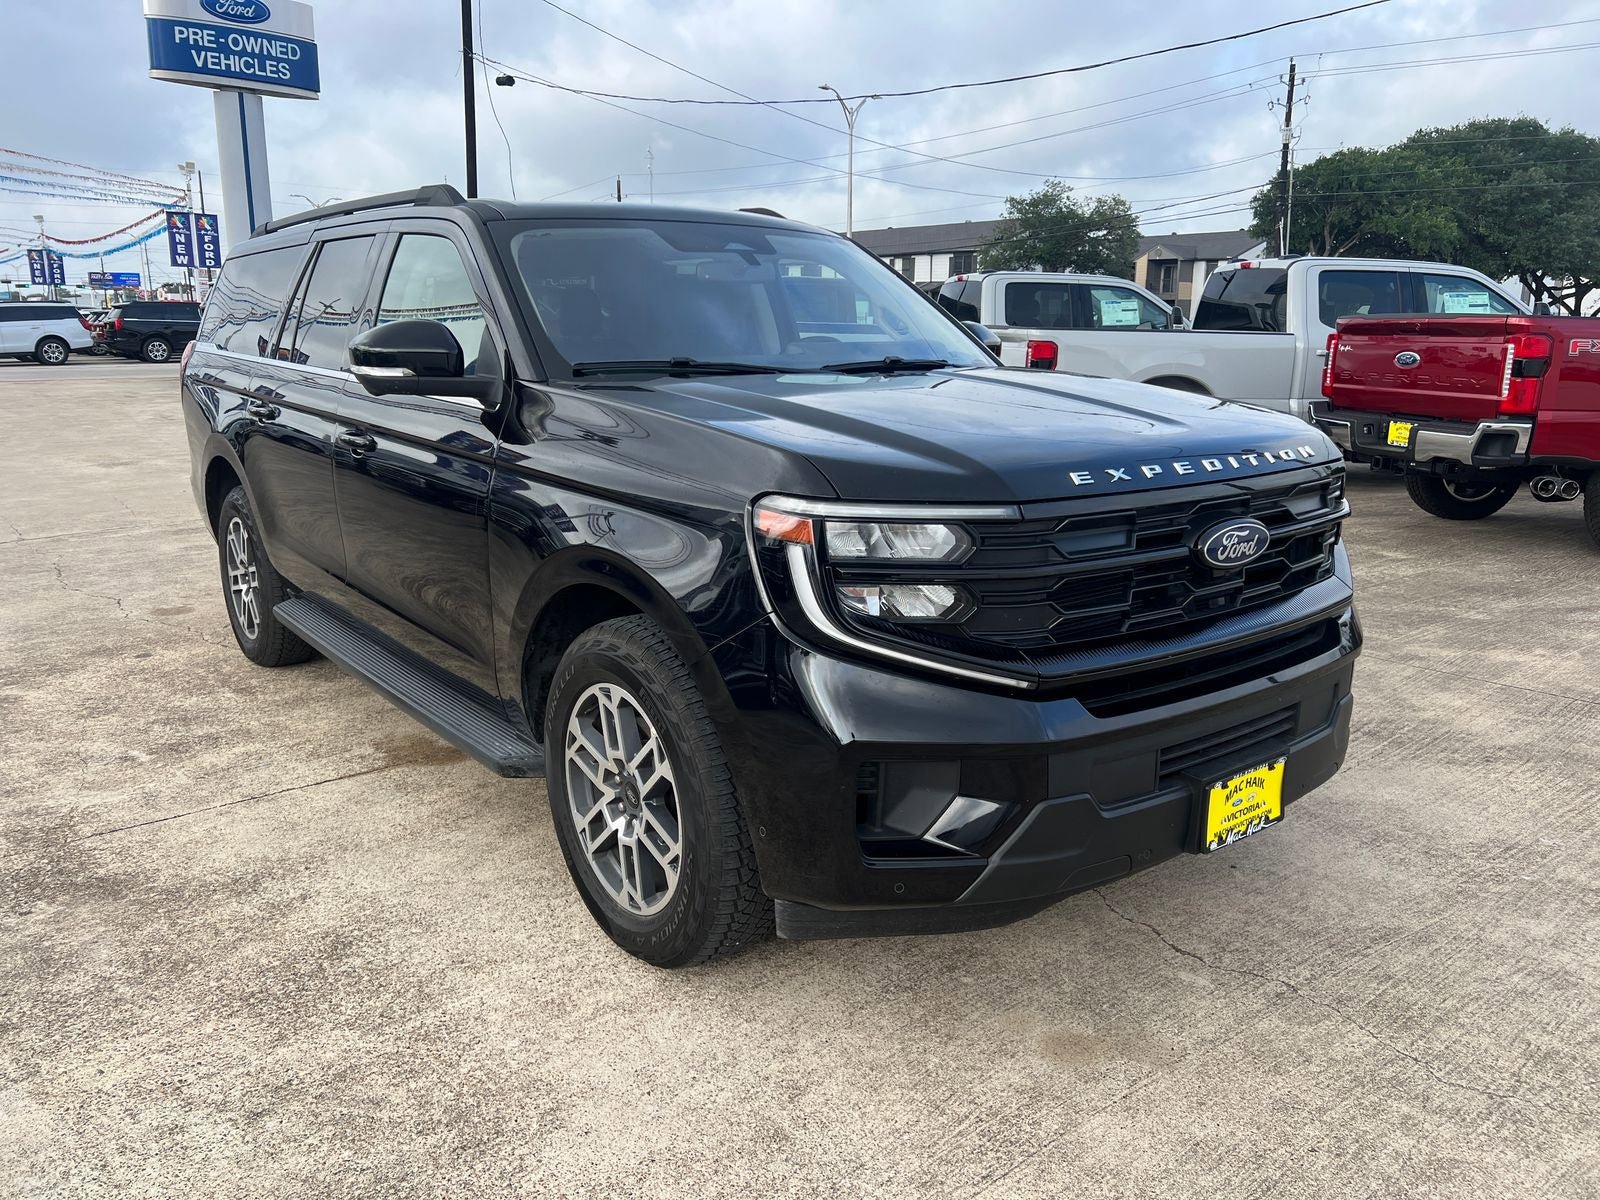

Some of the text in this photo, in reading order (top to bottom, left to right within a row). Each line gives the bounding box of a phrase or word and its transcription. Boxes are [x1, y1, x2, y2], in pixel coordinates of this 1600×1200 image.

[215, 0, 256, 17] Ford
[174, 26, 301, 60] PRE-OWNED
[191, 50, 291, 79] VEHICLES
[175, 233, 188, 264] NEW
[203, 235, 215, 266] FORD
[1069, 445, 1316, 486] EXPEDITION
[1217, 529, 1259, 561] Ford
[1225, 780, 1244, 806] MAC
[1245, 776, 1265, 790] HAIK
[1226, 802, 1261, 823] VICTORIA
